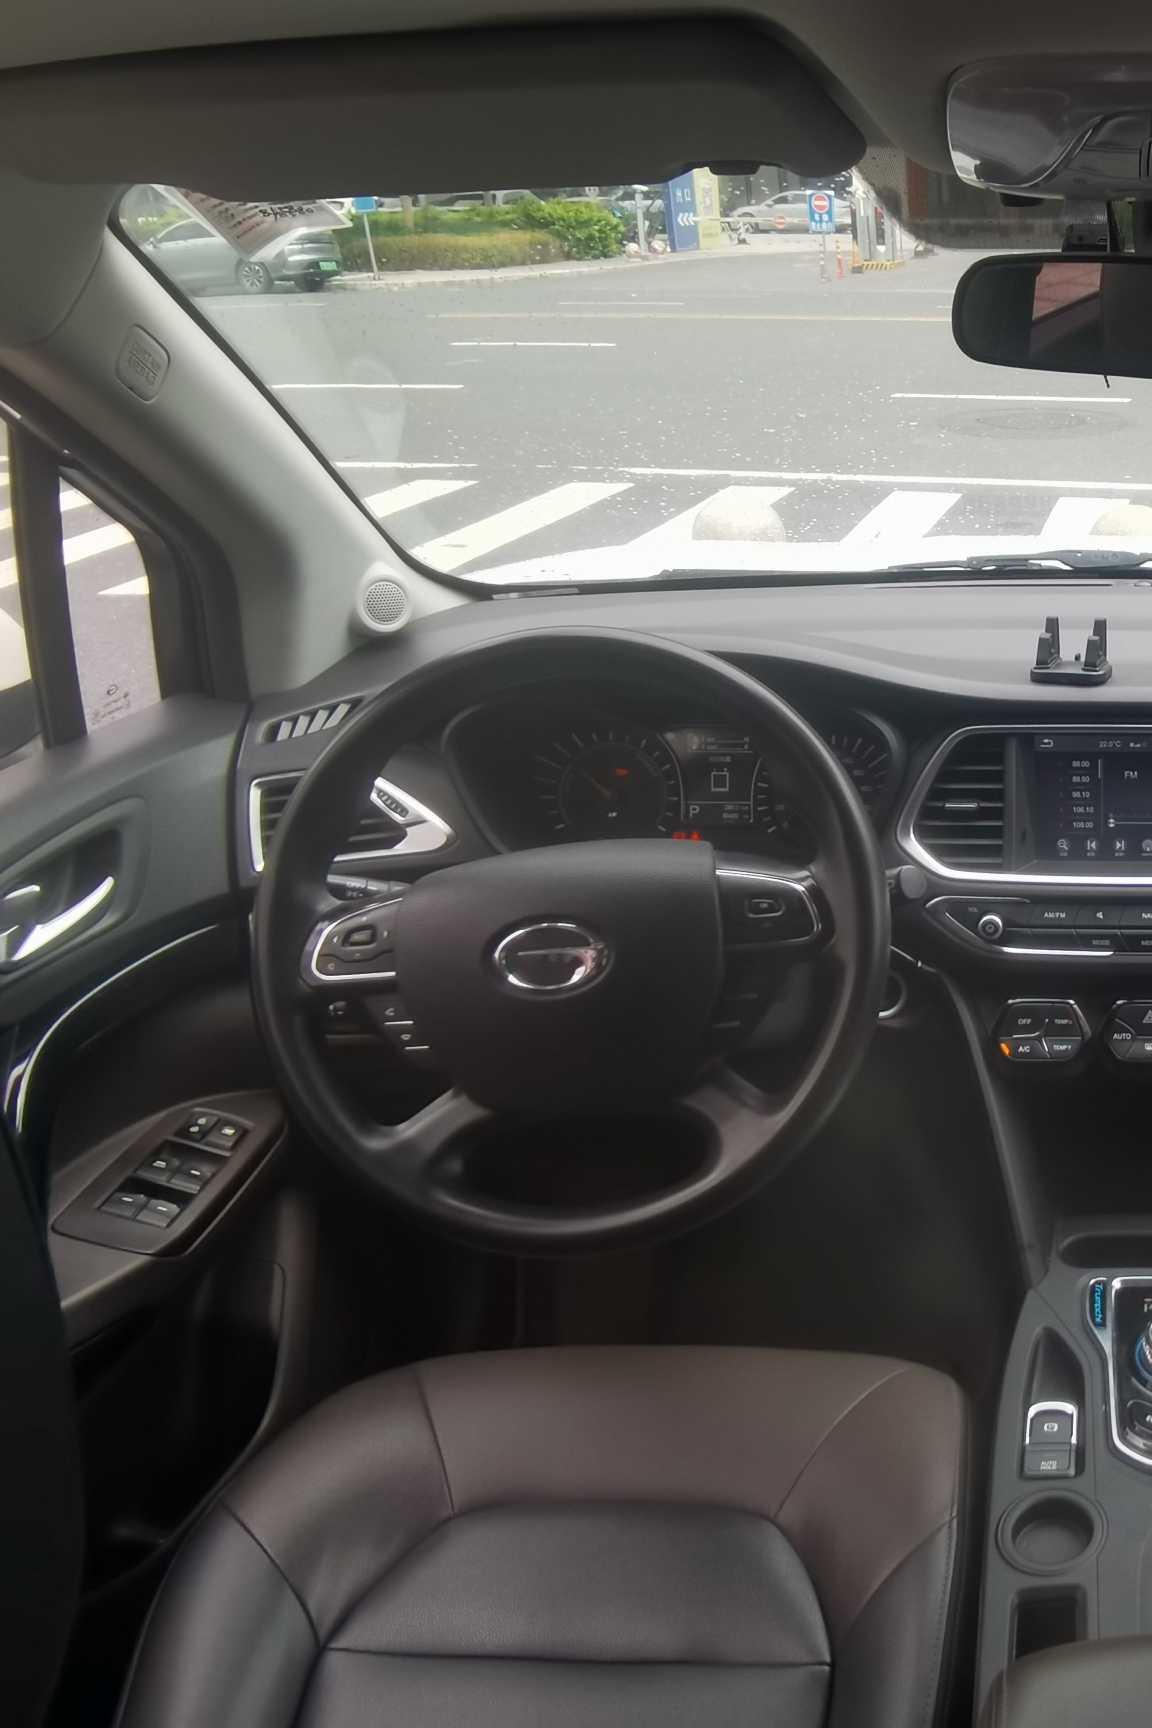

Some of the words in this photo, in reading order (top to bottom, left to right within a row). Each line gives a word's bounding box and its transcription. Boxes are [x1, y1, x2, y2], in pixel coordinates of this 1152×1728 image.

[1124, 770, 1138, 779] FM
[689, 804, 700, 817] P
[1017, 1018, 1032, 1026] OFF
[1112, 1032, 1132, 1041] AUTO
[1017, 1045, 1031, 1053] A/C
